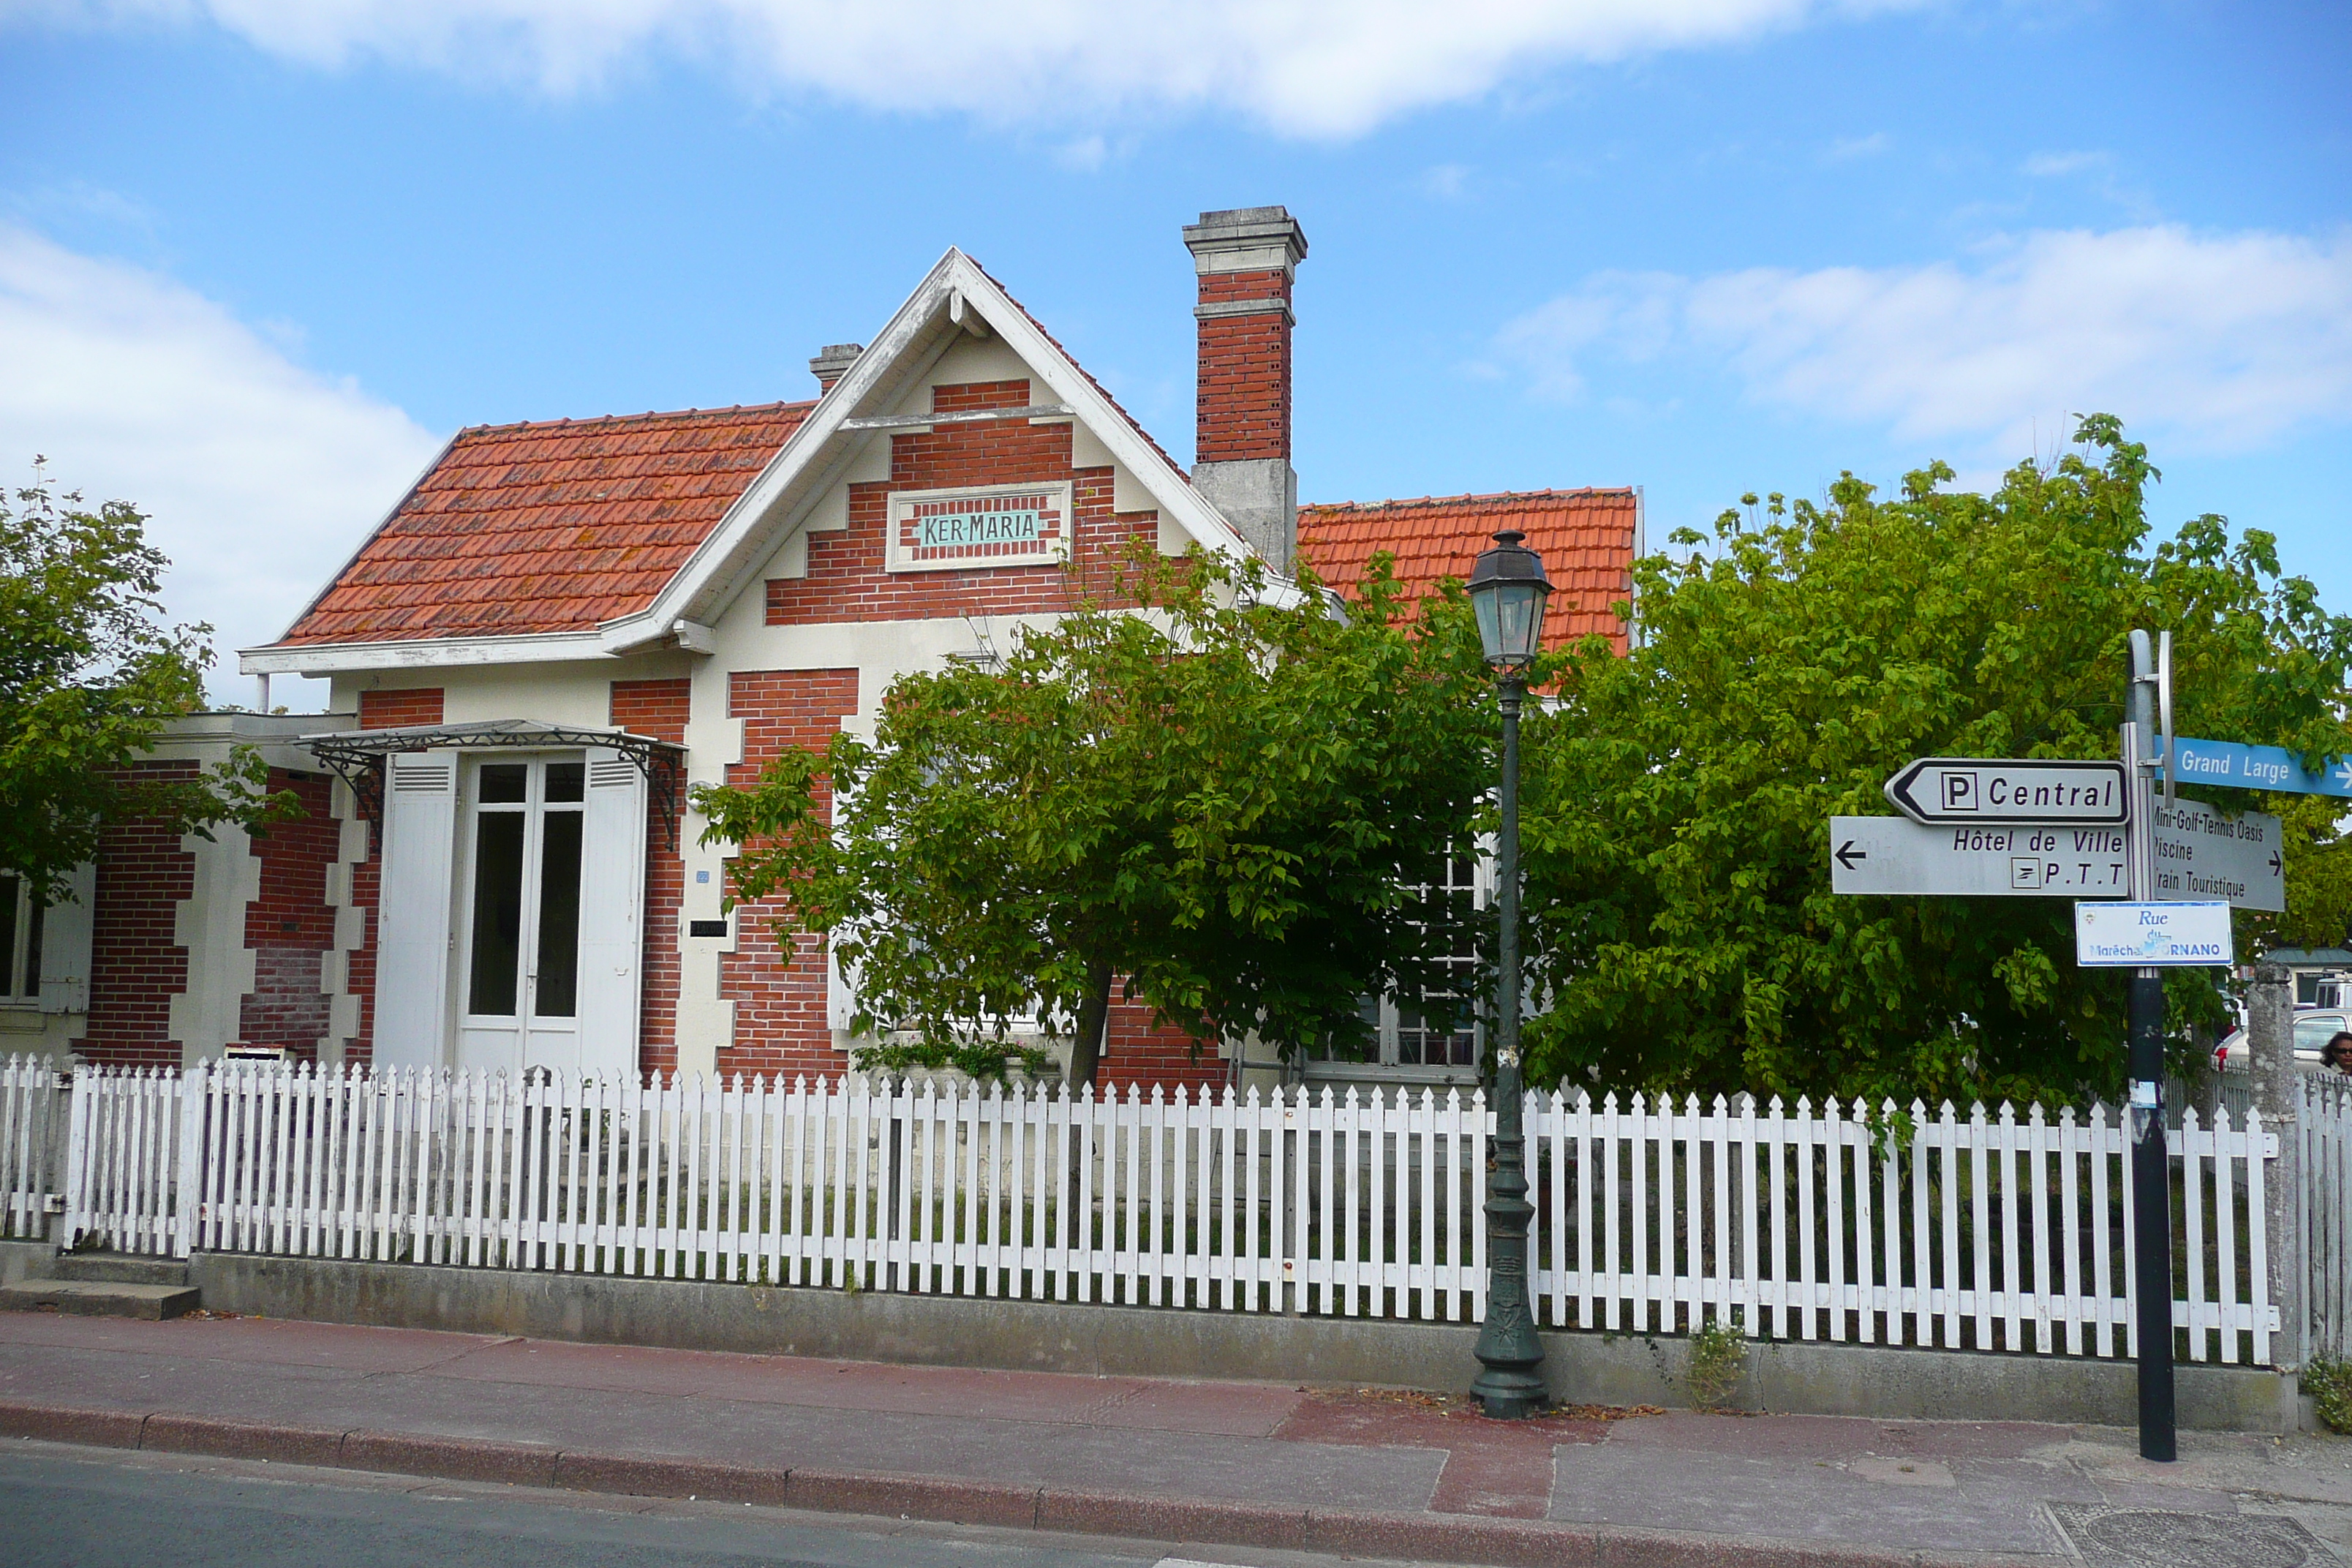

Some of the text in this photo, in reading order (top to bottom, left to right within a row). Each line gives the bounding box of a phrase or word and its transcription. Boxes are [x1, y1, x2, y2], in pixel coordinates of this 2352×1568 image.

[924, 514, 1035, 544] KER-MARIA
[2182, 750, 2289, 784] Grand Large
[1948, 777, 2112, 807] P Central
[1953, 829, 2122, 853] Hôtel de Ville
[2237, 820, 2264, 843] Oasis
[2046, 863, 2123, 885] P.T.T
[2156, 867, 2245, 901] rain Touristique
[2138, 911, 2168, 925] Rue
[2147, 929, 2160, 939] du
